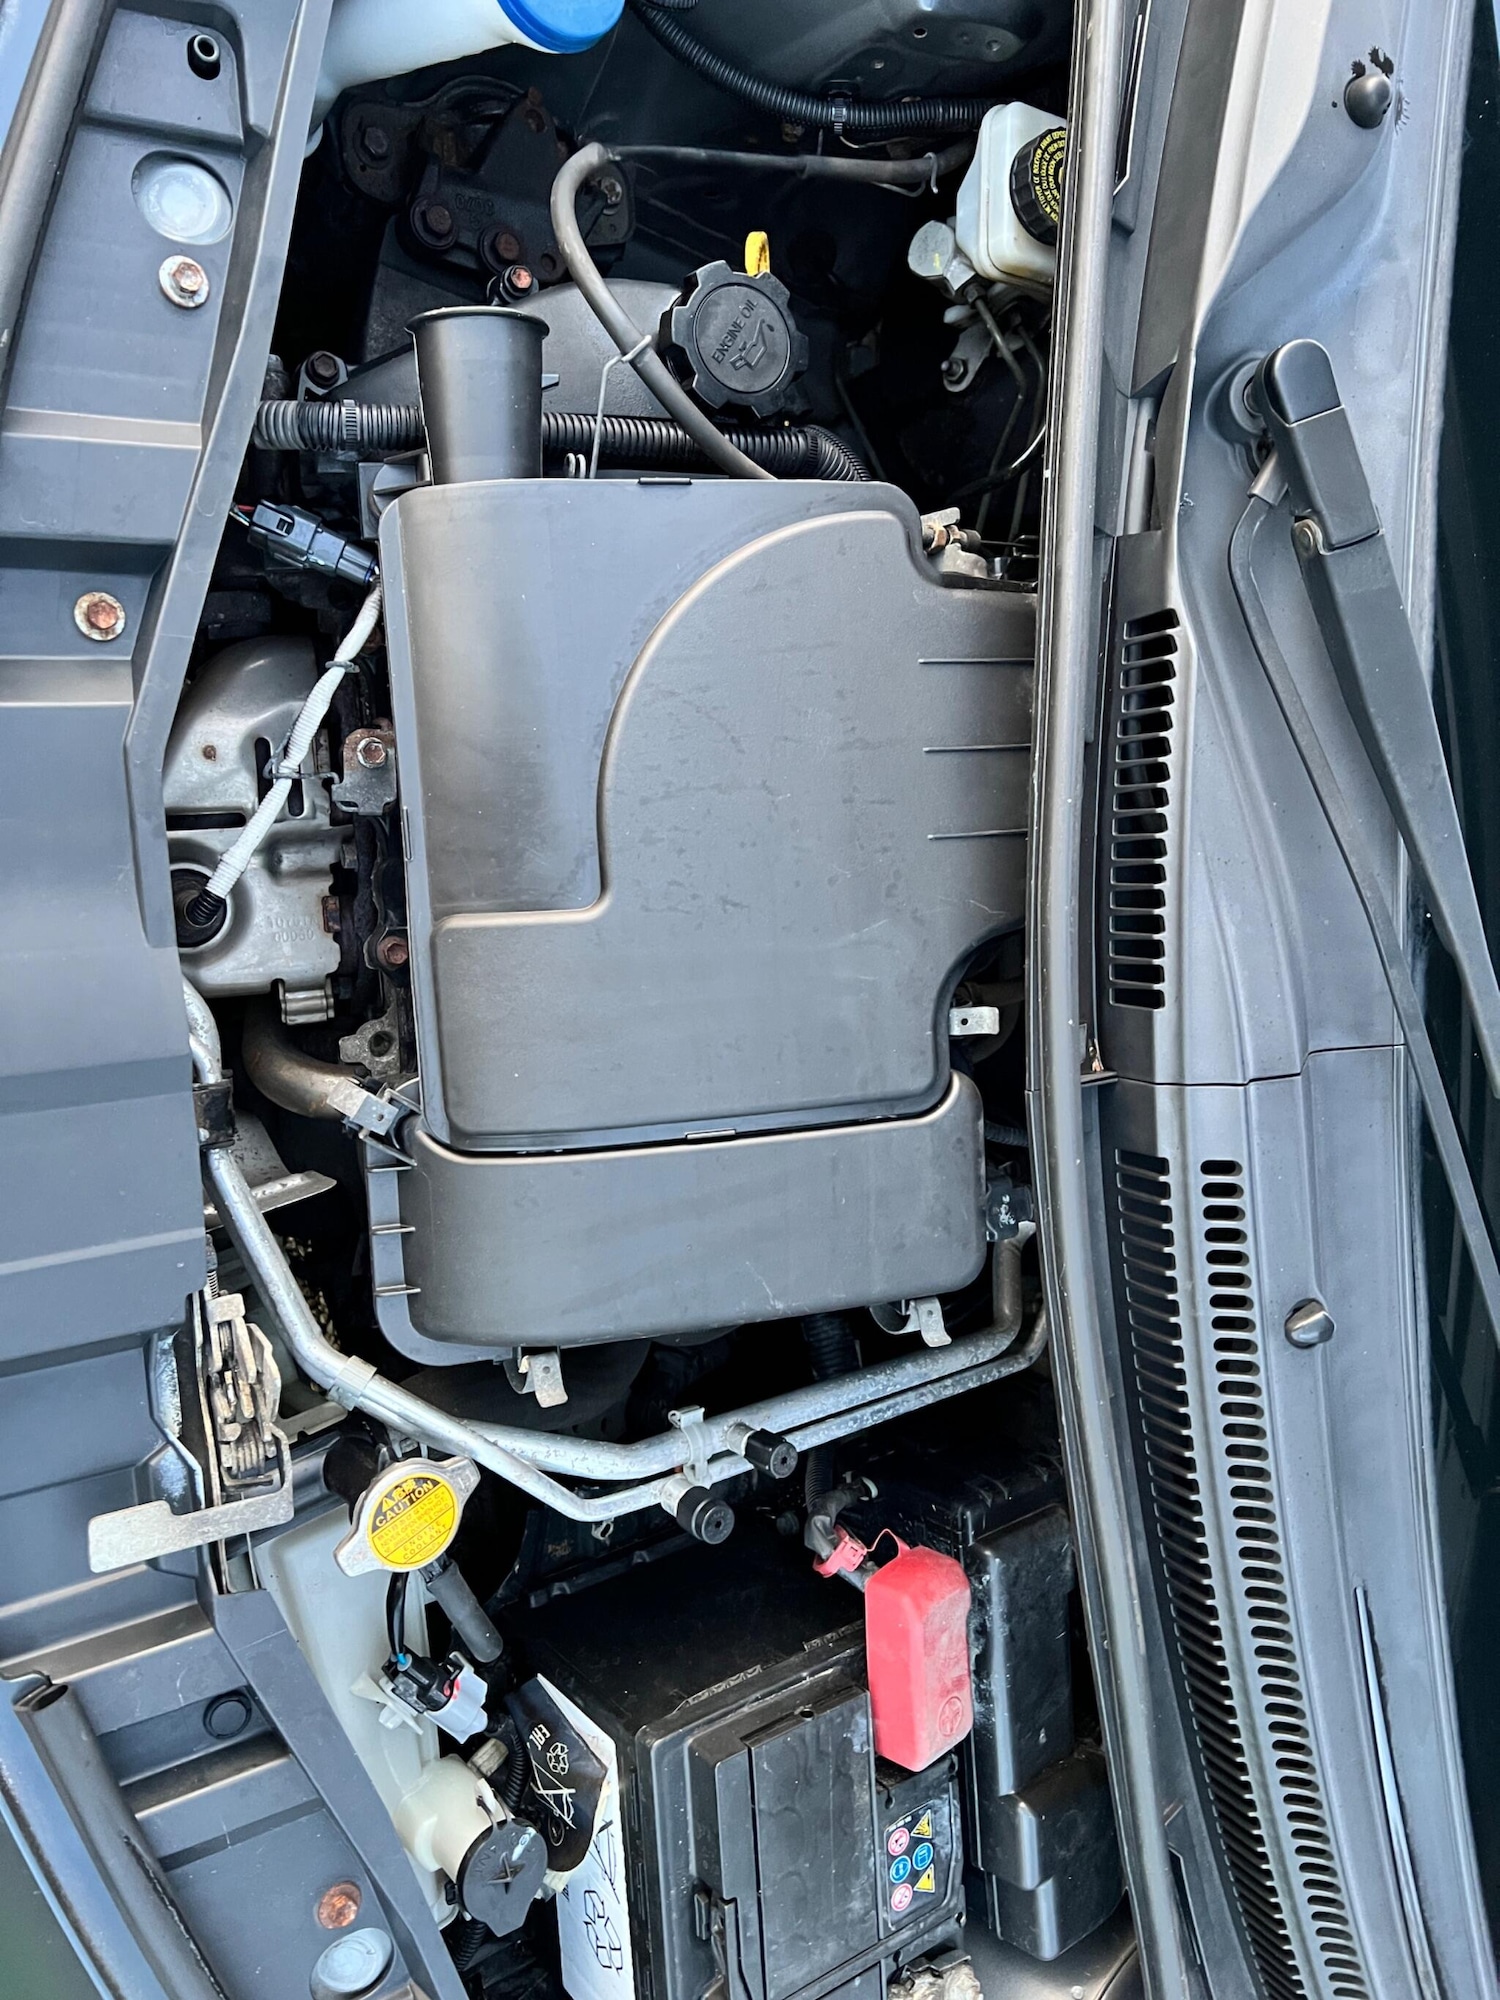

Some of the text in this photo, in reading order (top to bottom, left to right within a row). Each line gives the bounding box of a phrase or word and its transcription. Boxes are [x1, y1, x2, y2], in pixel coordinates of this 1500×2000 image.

[1035, 185, 1051, 214] NETTOYER
[711, 299, 758, 364] ENGINE OIL
[376, 1480, 434, 1527] CAUTION
[380, 1530, 401, 1548] NEVER
[399, 1518, 417, 1533] OPEN
[415, 1505, 434, 1521] WHEN
[401, 1519, 441, 1552] ENGINE
[401, 1523, 448, 1560] COOLANT
